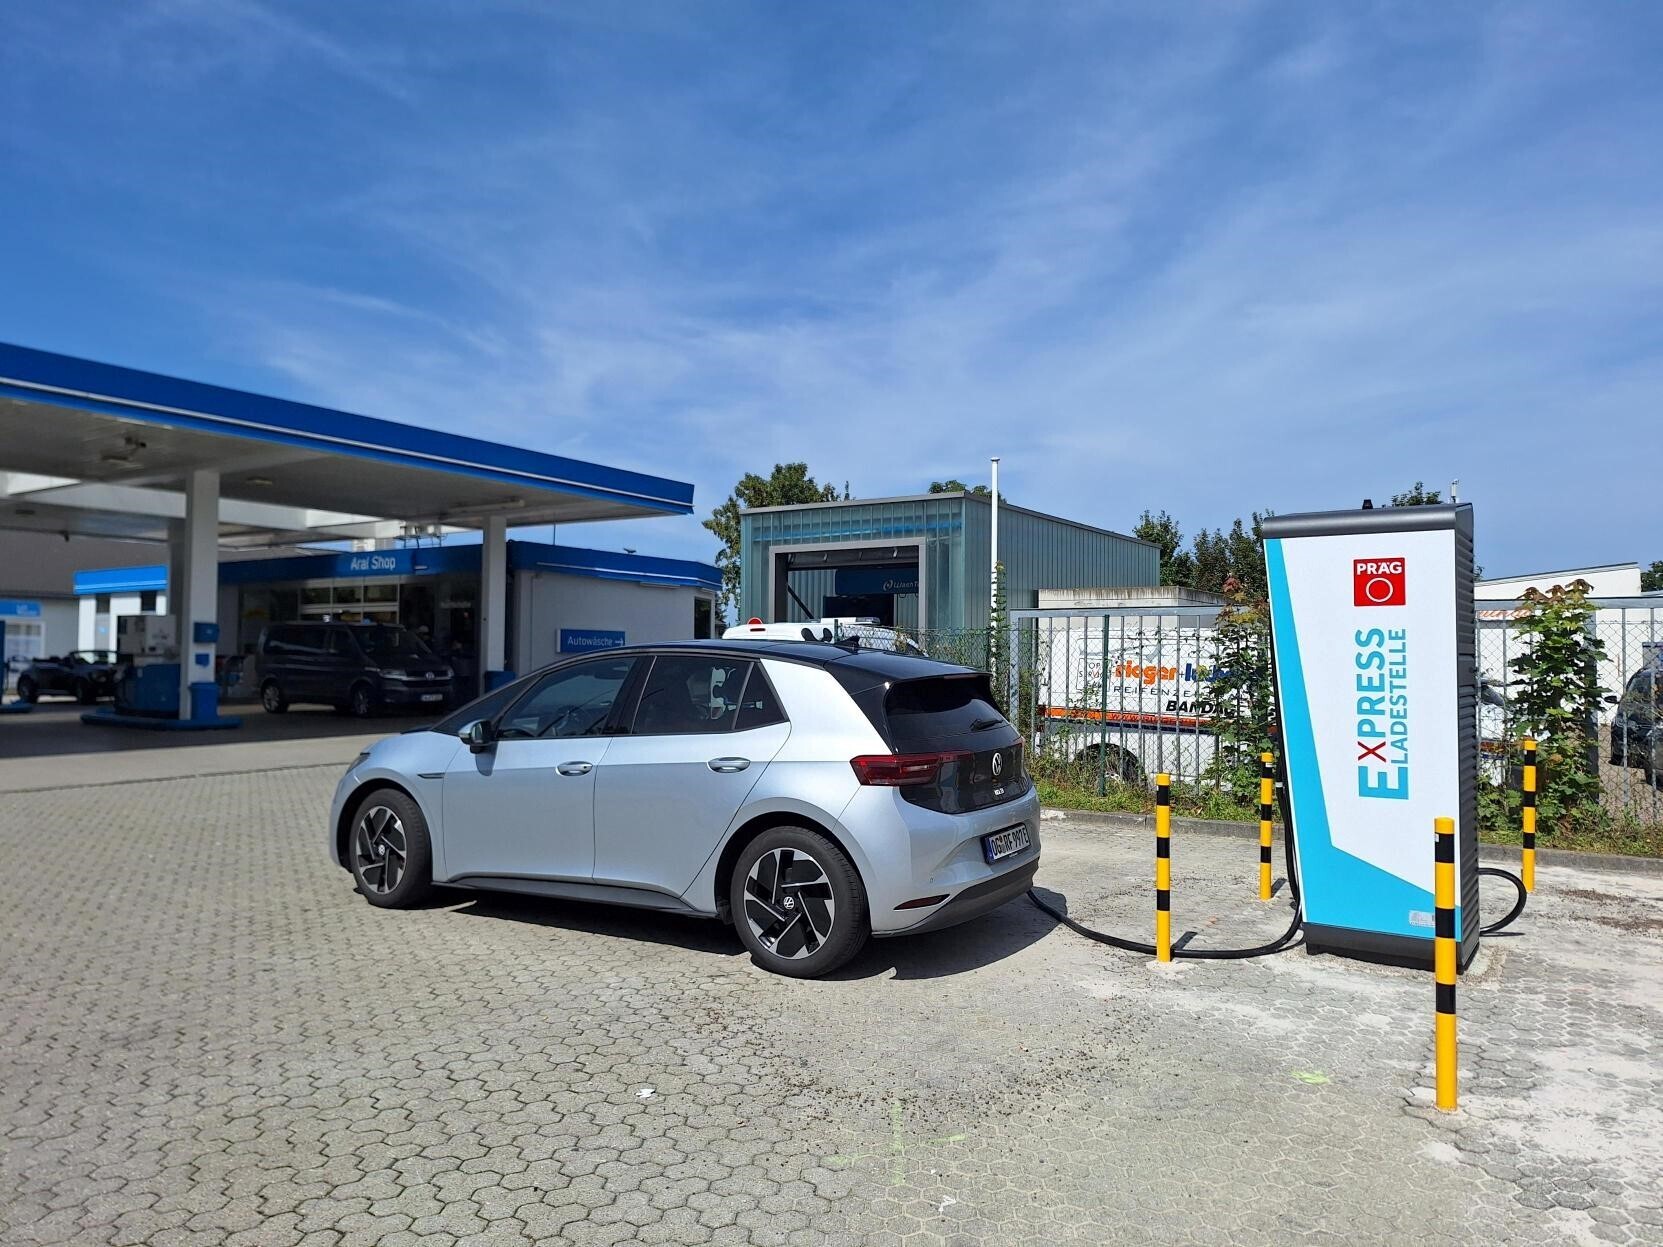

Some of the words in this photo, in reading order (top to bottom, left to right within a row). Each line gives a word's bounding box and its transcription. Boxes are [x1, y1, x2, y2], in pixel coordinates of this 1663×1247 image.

[351, 556, 370, 570] Aral
[371, 555, 396, 571] Shop
[1356, 561, 1403, 575] PRÄG
[567, 635, 613, 646] Autowäsche
[1387, 628, 1408, 764] LADESTELLE
[1355, 628, 1409, 800] EXPRESS
